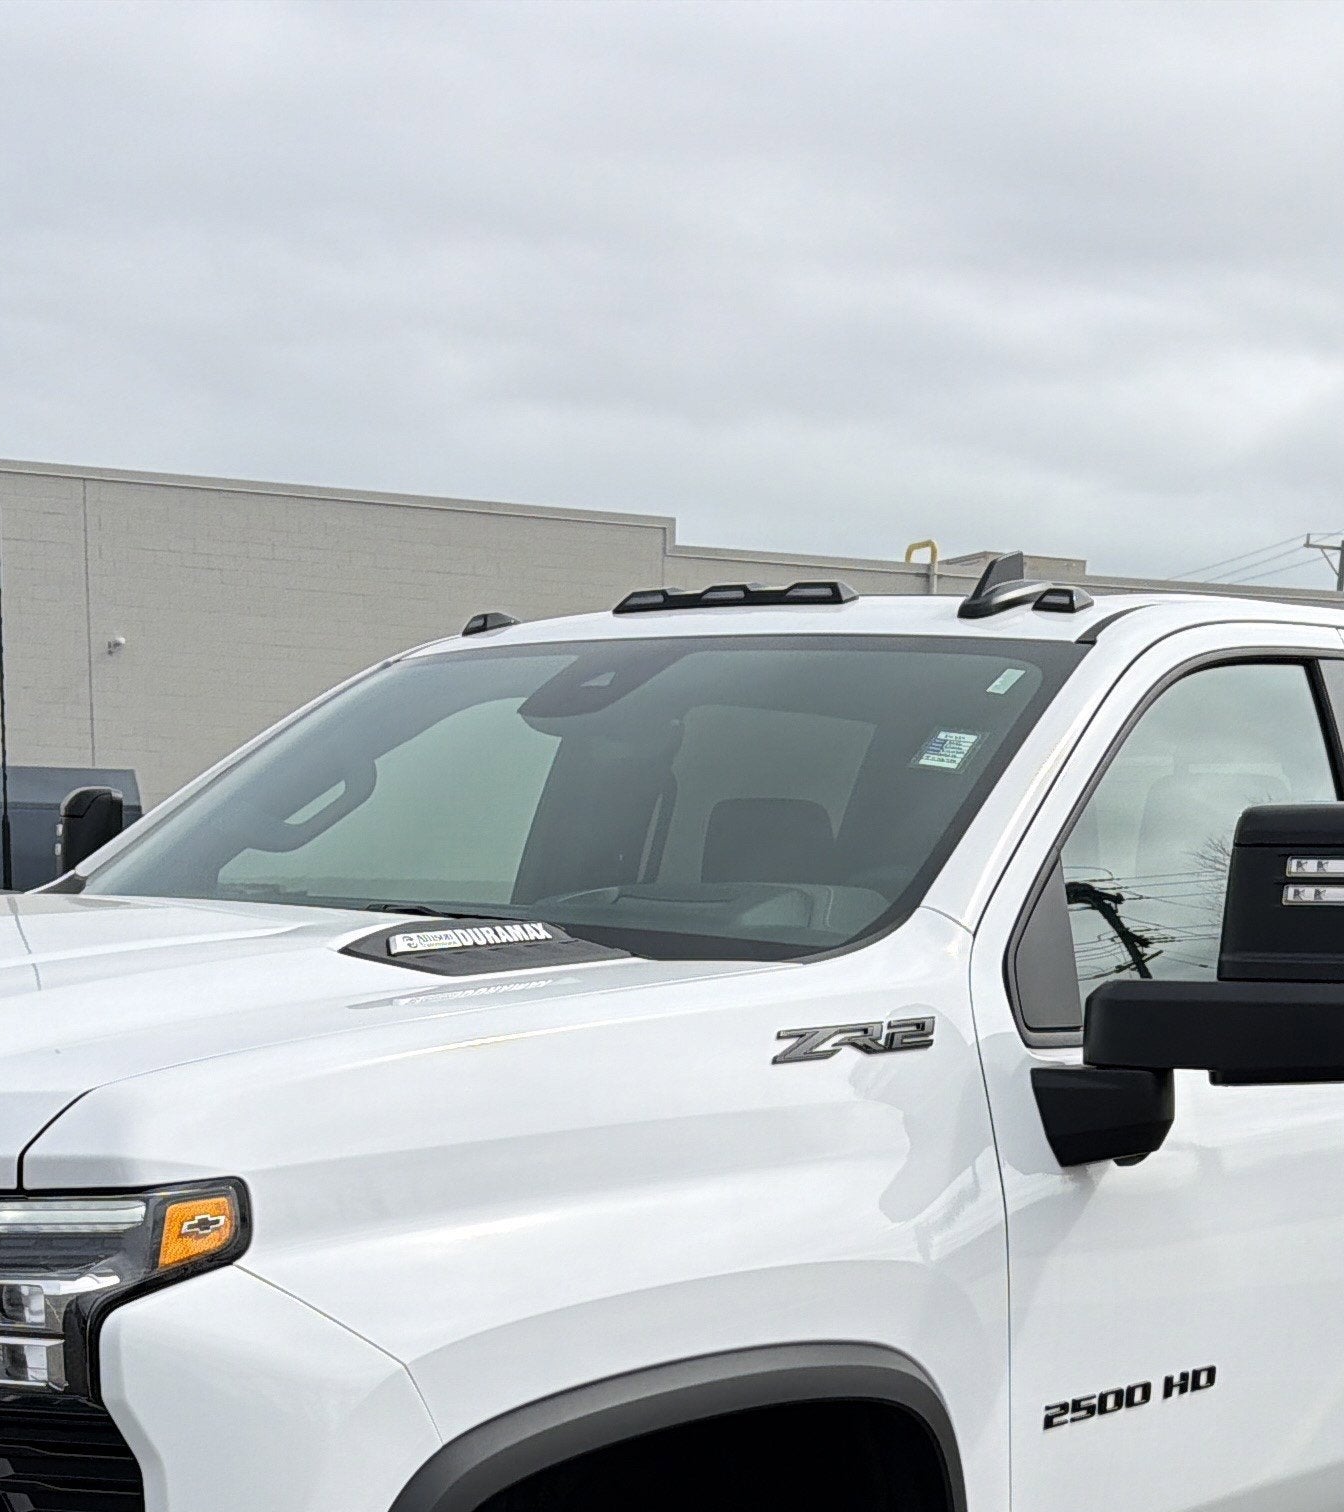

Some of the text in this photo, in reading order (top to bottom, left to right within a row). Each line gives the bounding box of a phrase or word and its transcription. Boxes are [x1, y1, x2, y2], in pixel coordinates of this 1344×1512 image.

[457, 922, 553, 947] DURAMAX
[771, 1015, 936, 1065] ZR2
[1043, 1364, 1217, 1431] 2500 HD
